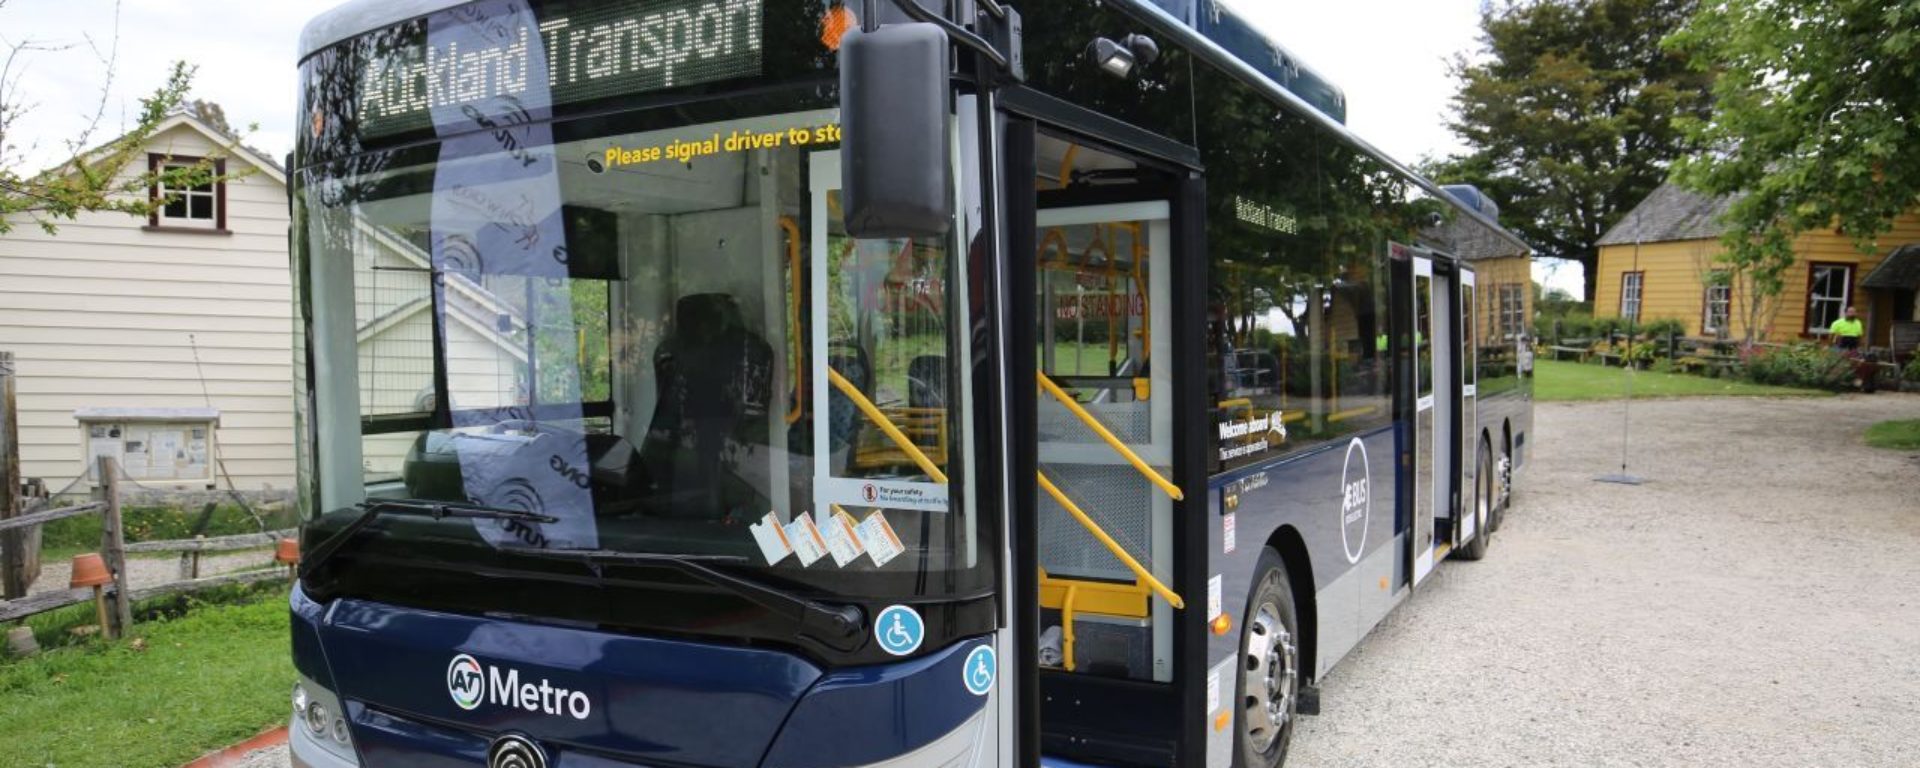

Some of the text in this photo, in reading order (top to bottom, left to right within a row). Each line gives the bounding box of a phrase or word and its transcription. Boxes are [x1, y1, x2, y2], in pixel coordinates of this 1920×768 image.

[360, 27, 528, 120] Auckland
[540, 0, 761, 87] Transport
[605, 145, 661, 169] Please
[666, 133, 719, 163] signal
[724, 130, 783, 151] driver
[788, 127, 809, 145] to
[1219, 420, 1248, 440] Welcome
[1352, 478, 1366, 507] BUS
[451, 665, 591, 720] AT Metro
